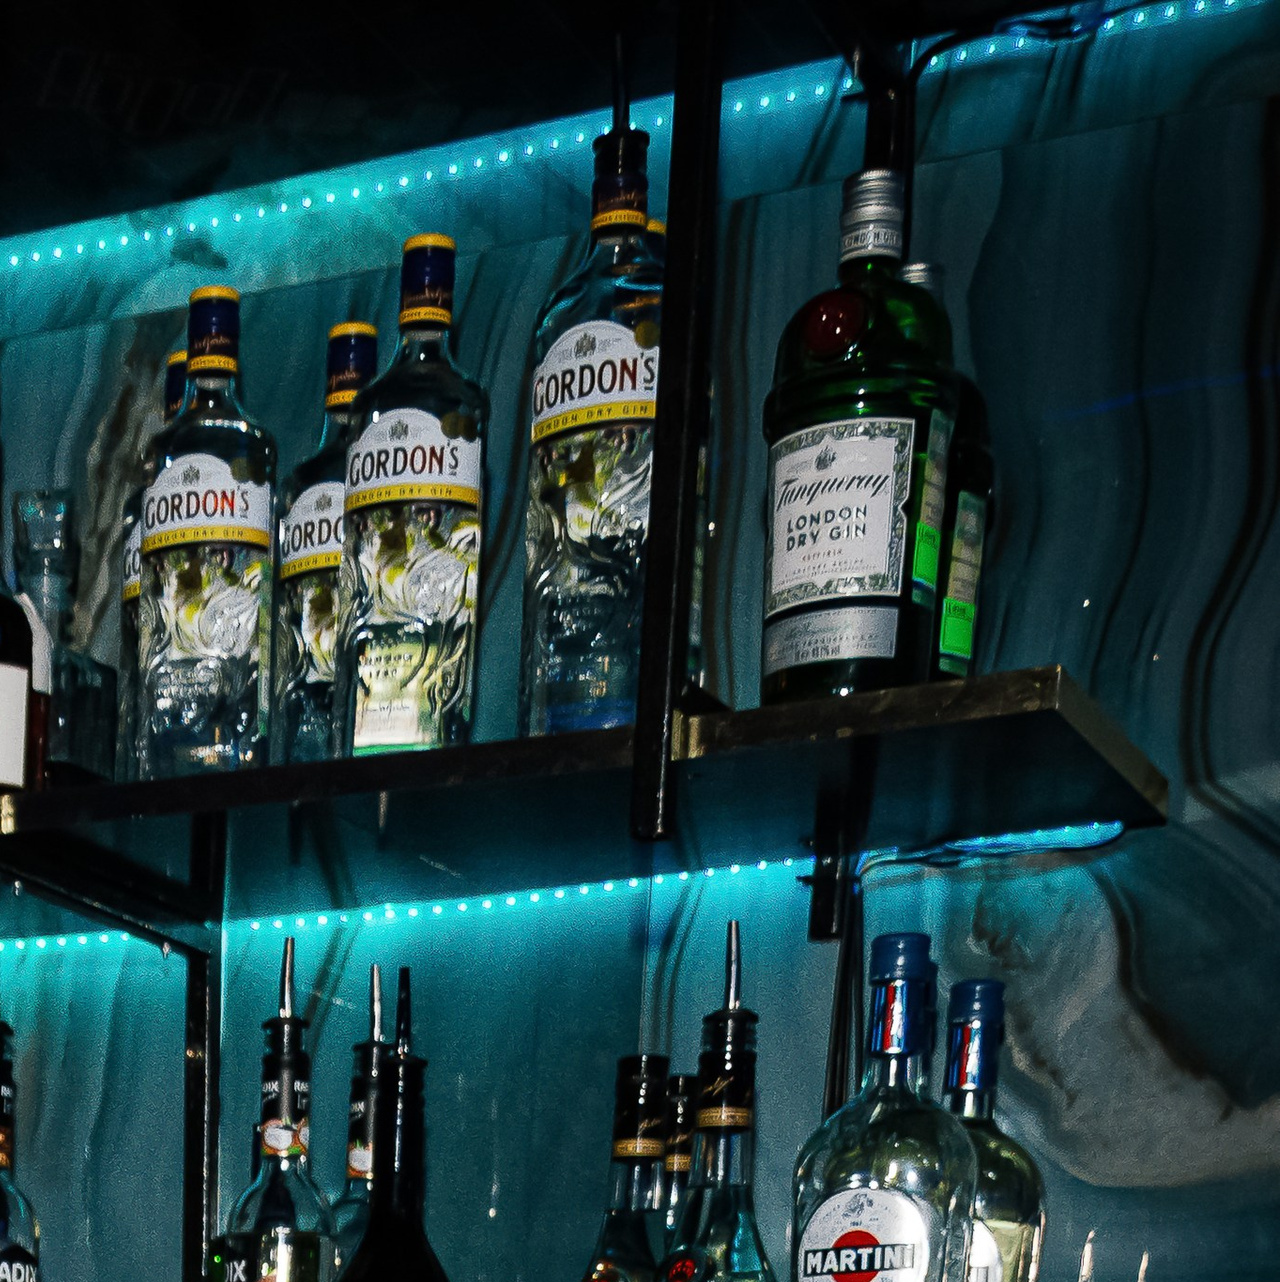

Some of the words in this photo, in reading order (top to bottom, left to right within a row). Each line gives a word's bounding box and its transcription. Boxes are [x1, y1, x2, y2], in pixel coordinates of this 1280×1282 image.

[533, 352, 656, 416] GORDON'S
[349, 440, 460, 487] GORDON'S
[145, 485, 250, 529] GORDON'S
[776, 474, 891, 512] Tanqueray
[282, 516, 344, 557] GORDO
[786, 530, 820, 552] DRY
[829, 522, 867, 541] GIN
[787, 504, 868, 534] LONDON
[806, 1243, 915, 1275] MARTINI
